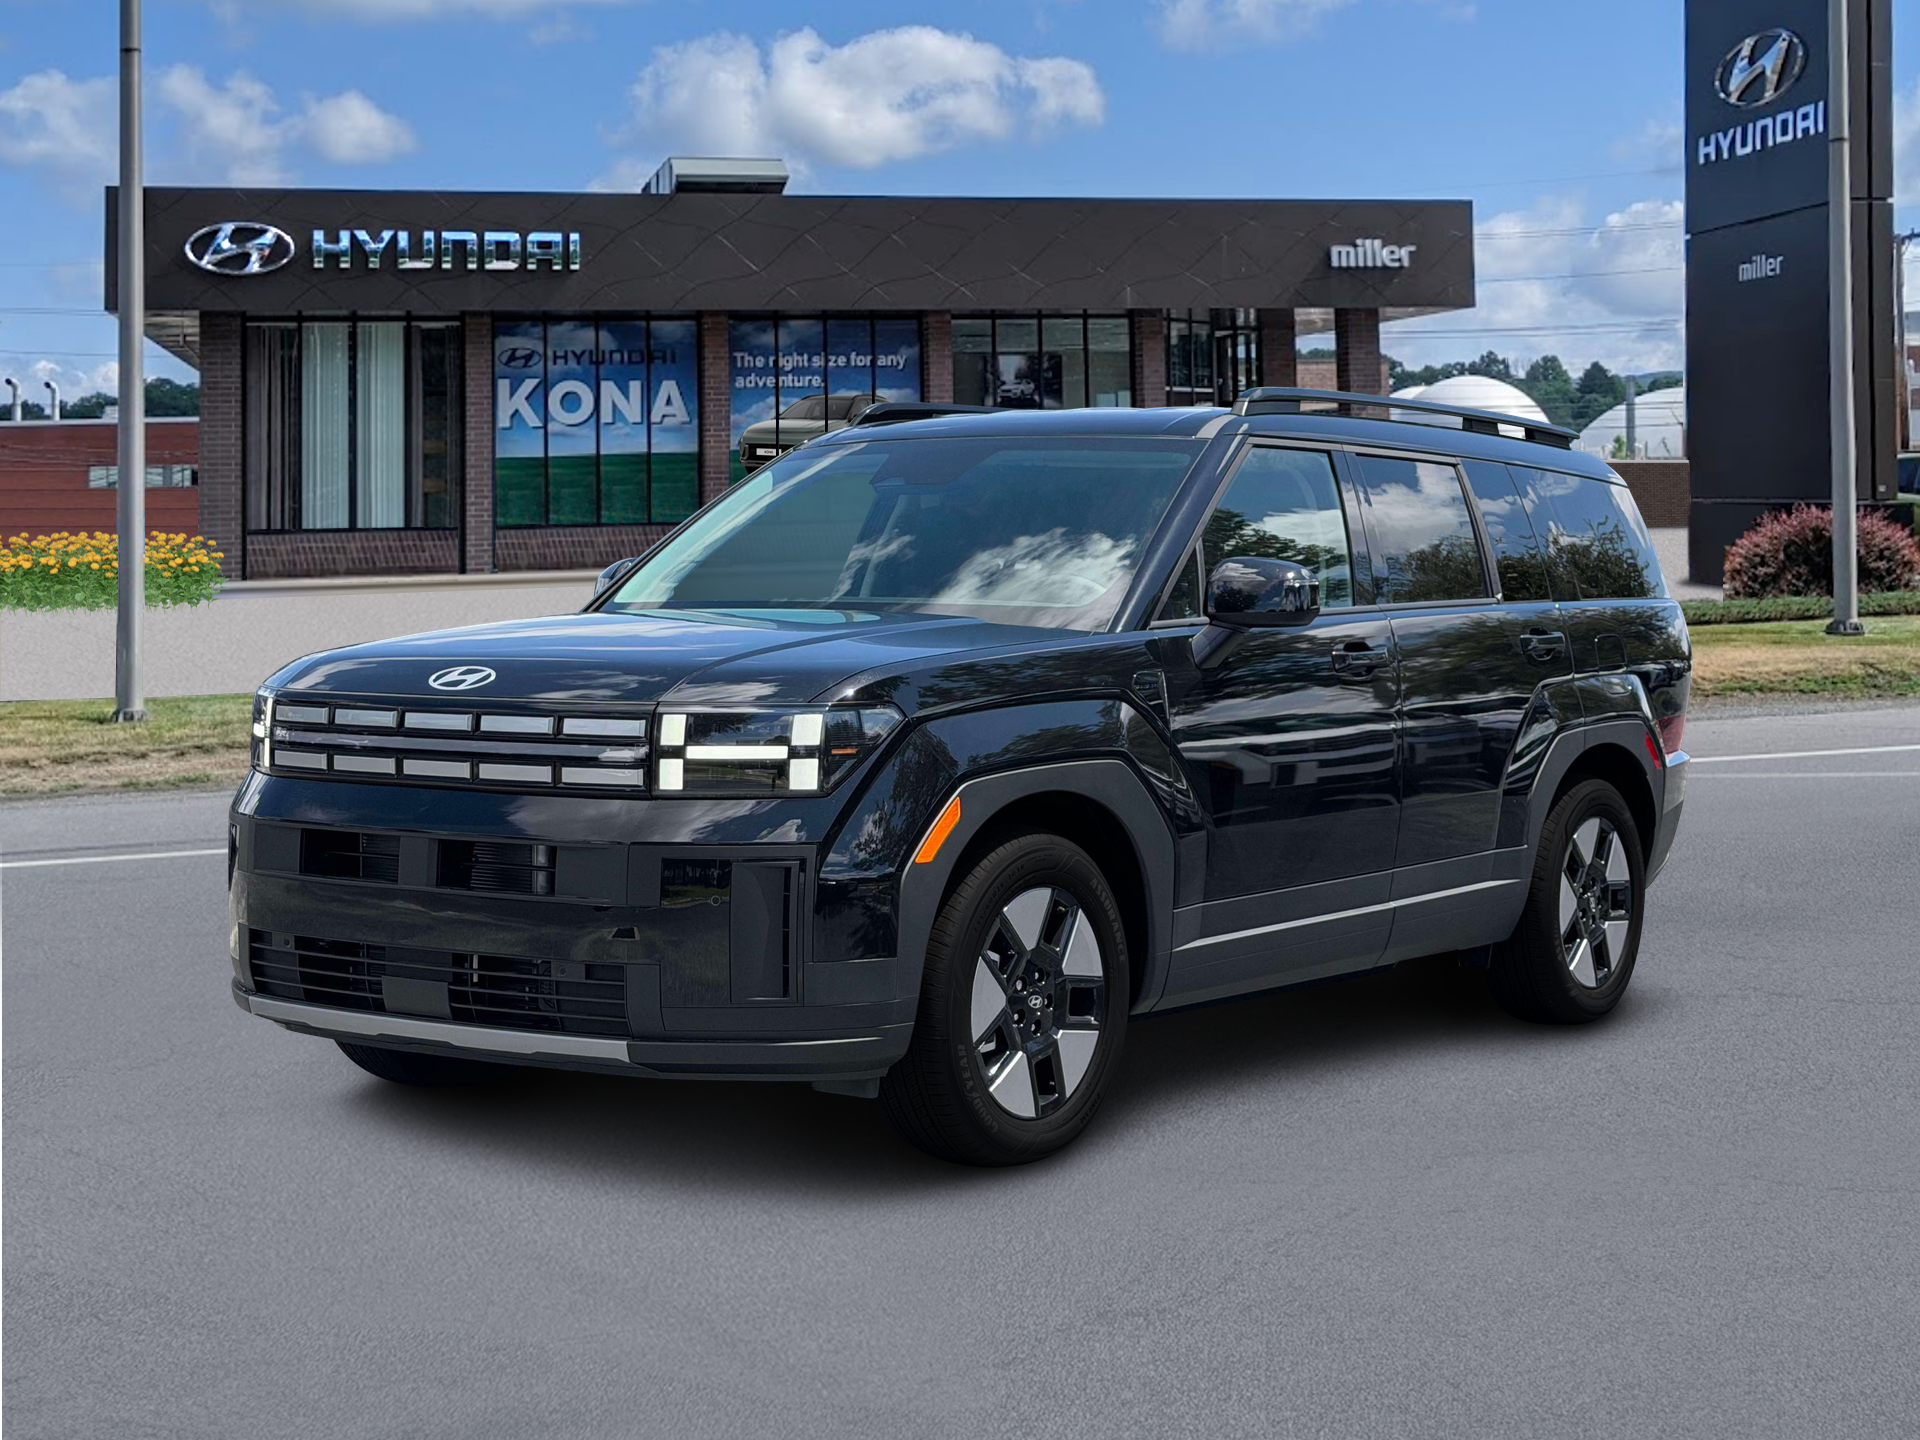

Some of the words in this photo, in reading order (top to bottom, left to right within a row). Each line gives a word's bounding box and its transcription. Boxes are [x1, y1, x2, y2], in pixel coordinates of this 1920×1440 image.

[1698, 100, 1824, 165] HYUNDAI
[312, 229, 580, 270] HYUNDAI
[1330, 238, 1417, 268] miller
[1738, 254, 1784, 282] miller
[552, 349, 677, 366] HYUNDAI
[733, 352, 764, 368] The
[769, 352, 808, 371] right
[811, 352, 847, 367] size
[850, 352, 873, 367] for
[877, 355, 907, 370] any
[735, 373, 825, 388] adventure.
[496, 377, 692, 429] KONA
[1089, 877, 1126, 962] ASSURANCE
[957, 1044, 999, 1133] GOODYEAR
